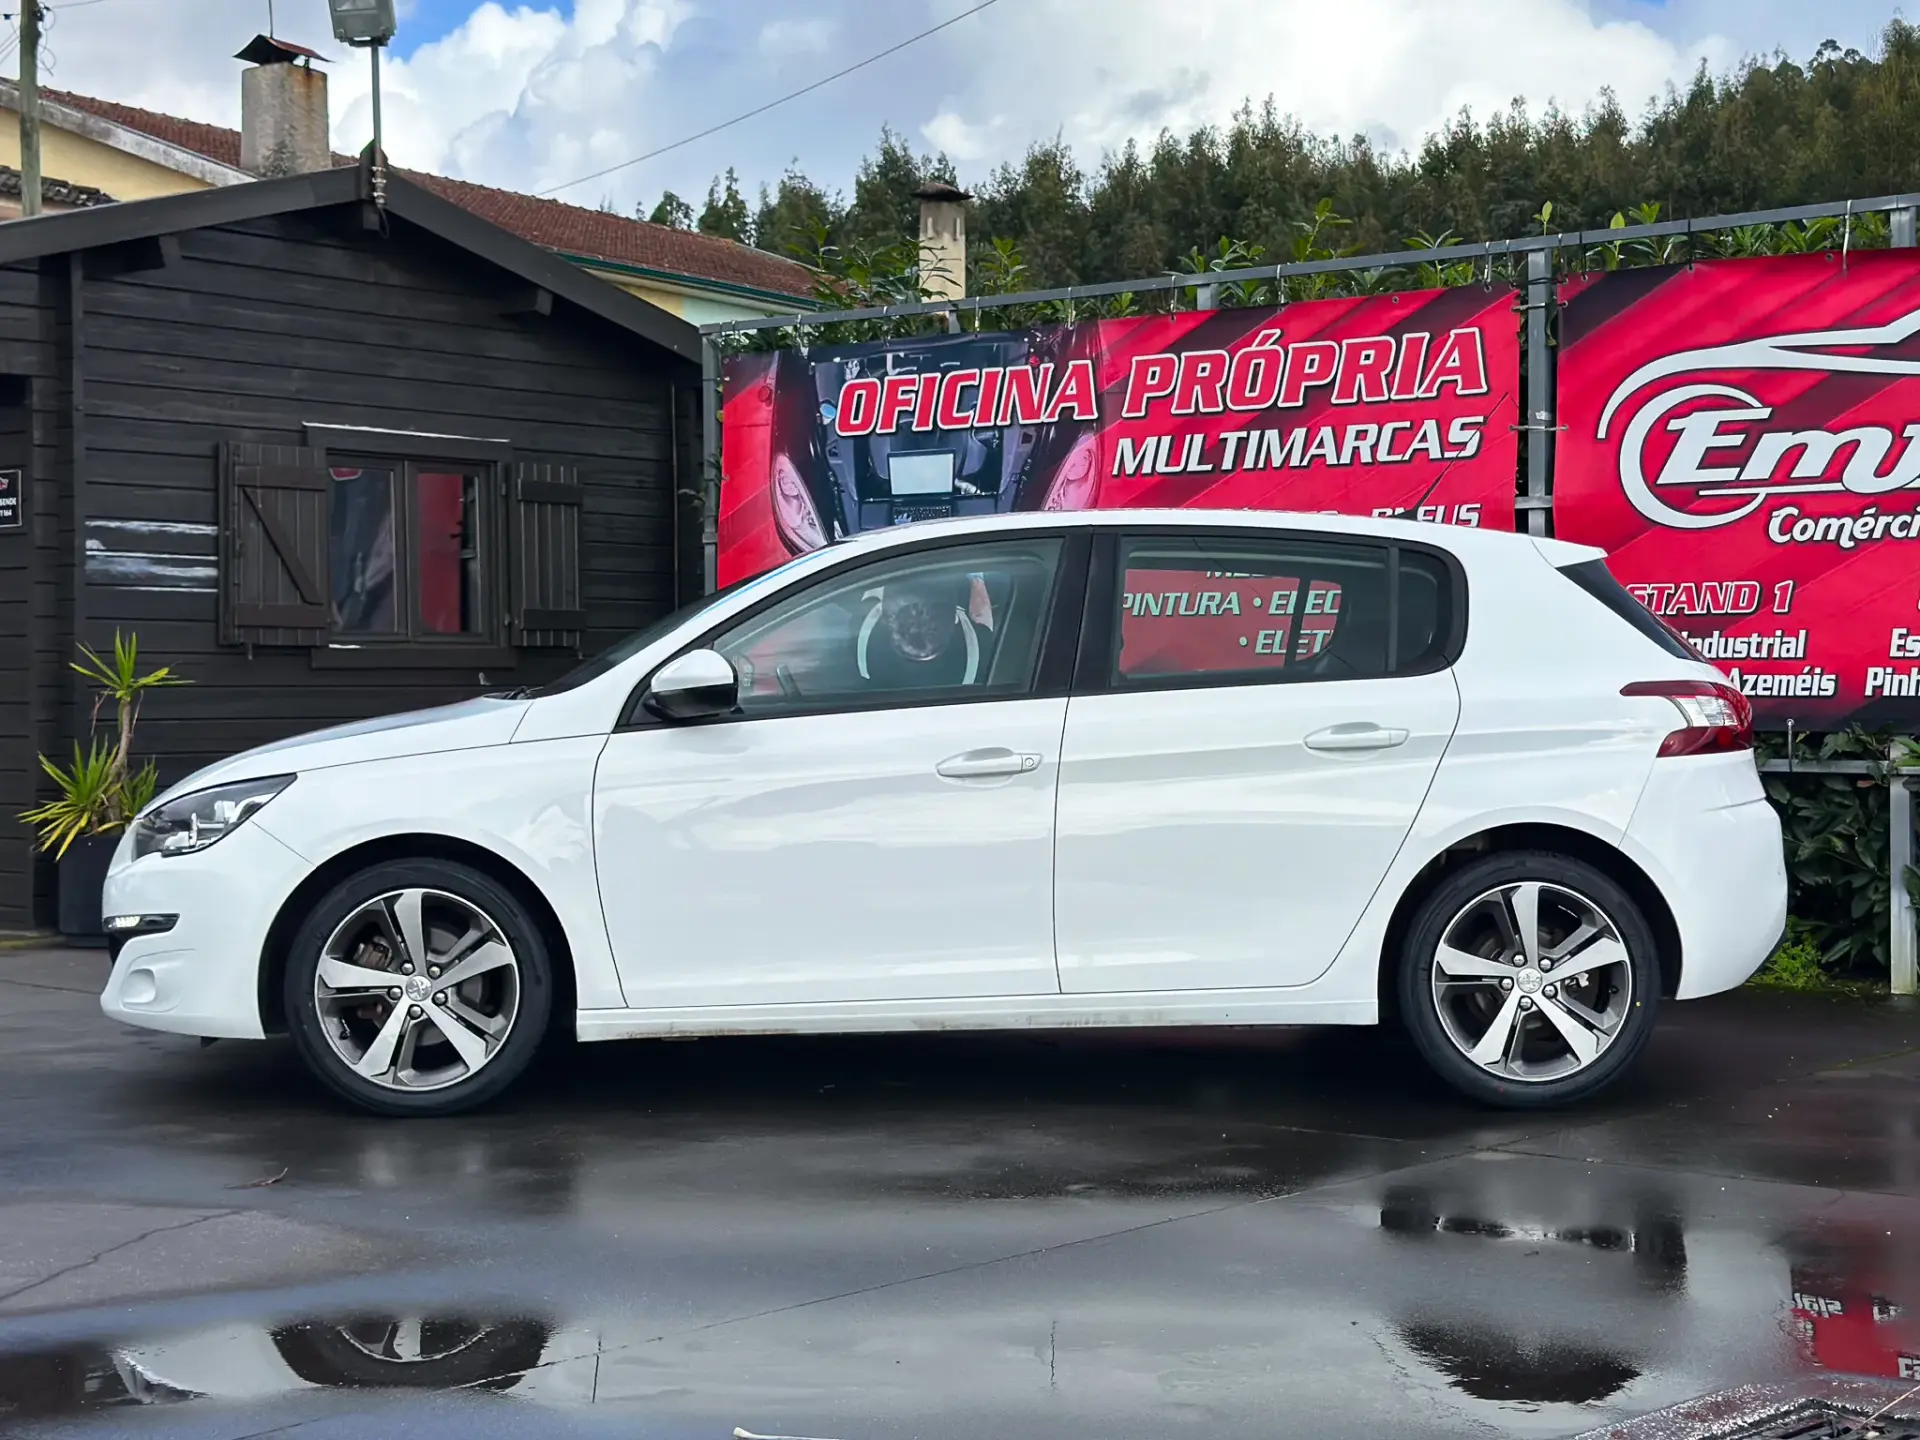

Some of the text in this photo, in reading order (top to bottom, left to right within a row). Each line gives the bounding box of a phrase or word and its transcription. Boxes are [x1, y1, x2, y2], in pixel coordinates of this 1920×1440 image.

[835, 327, 1488, 436] OFICINA PRÓPRIA
[1112, 416, 1484, 476] MULTIMARCAS
[1773, 580, 1794, 614] 1
[1889, 628, 1920, 657] Es
[1728, 666, 1836, 697] Azeméis
